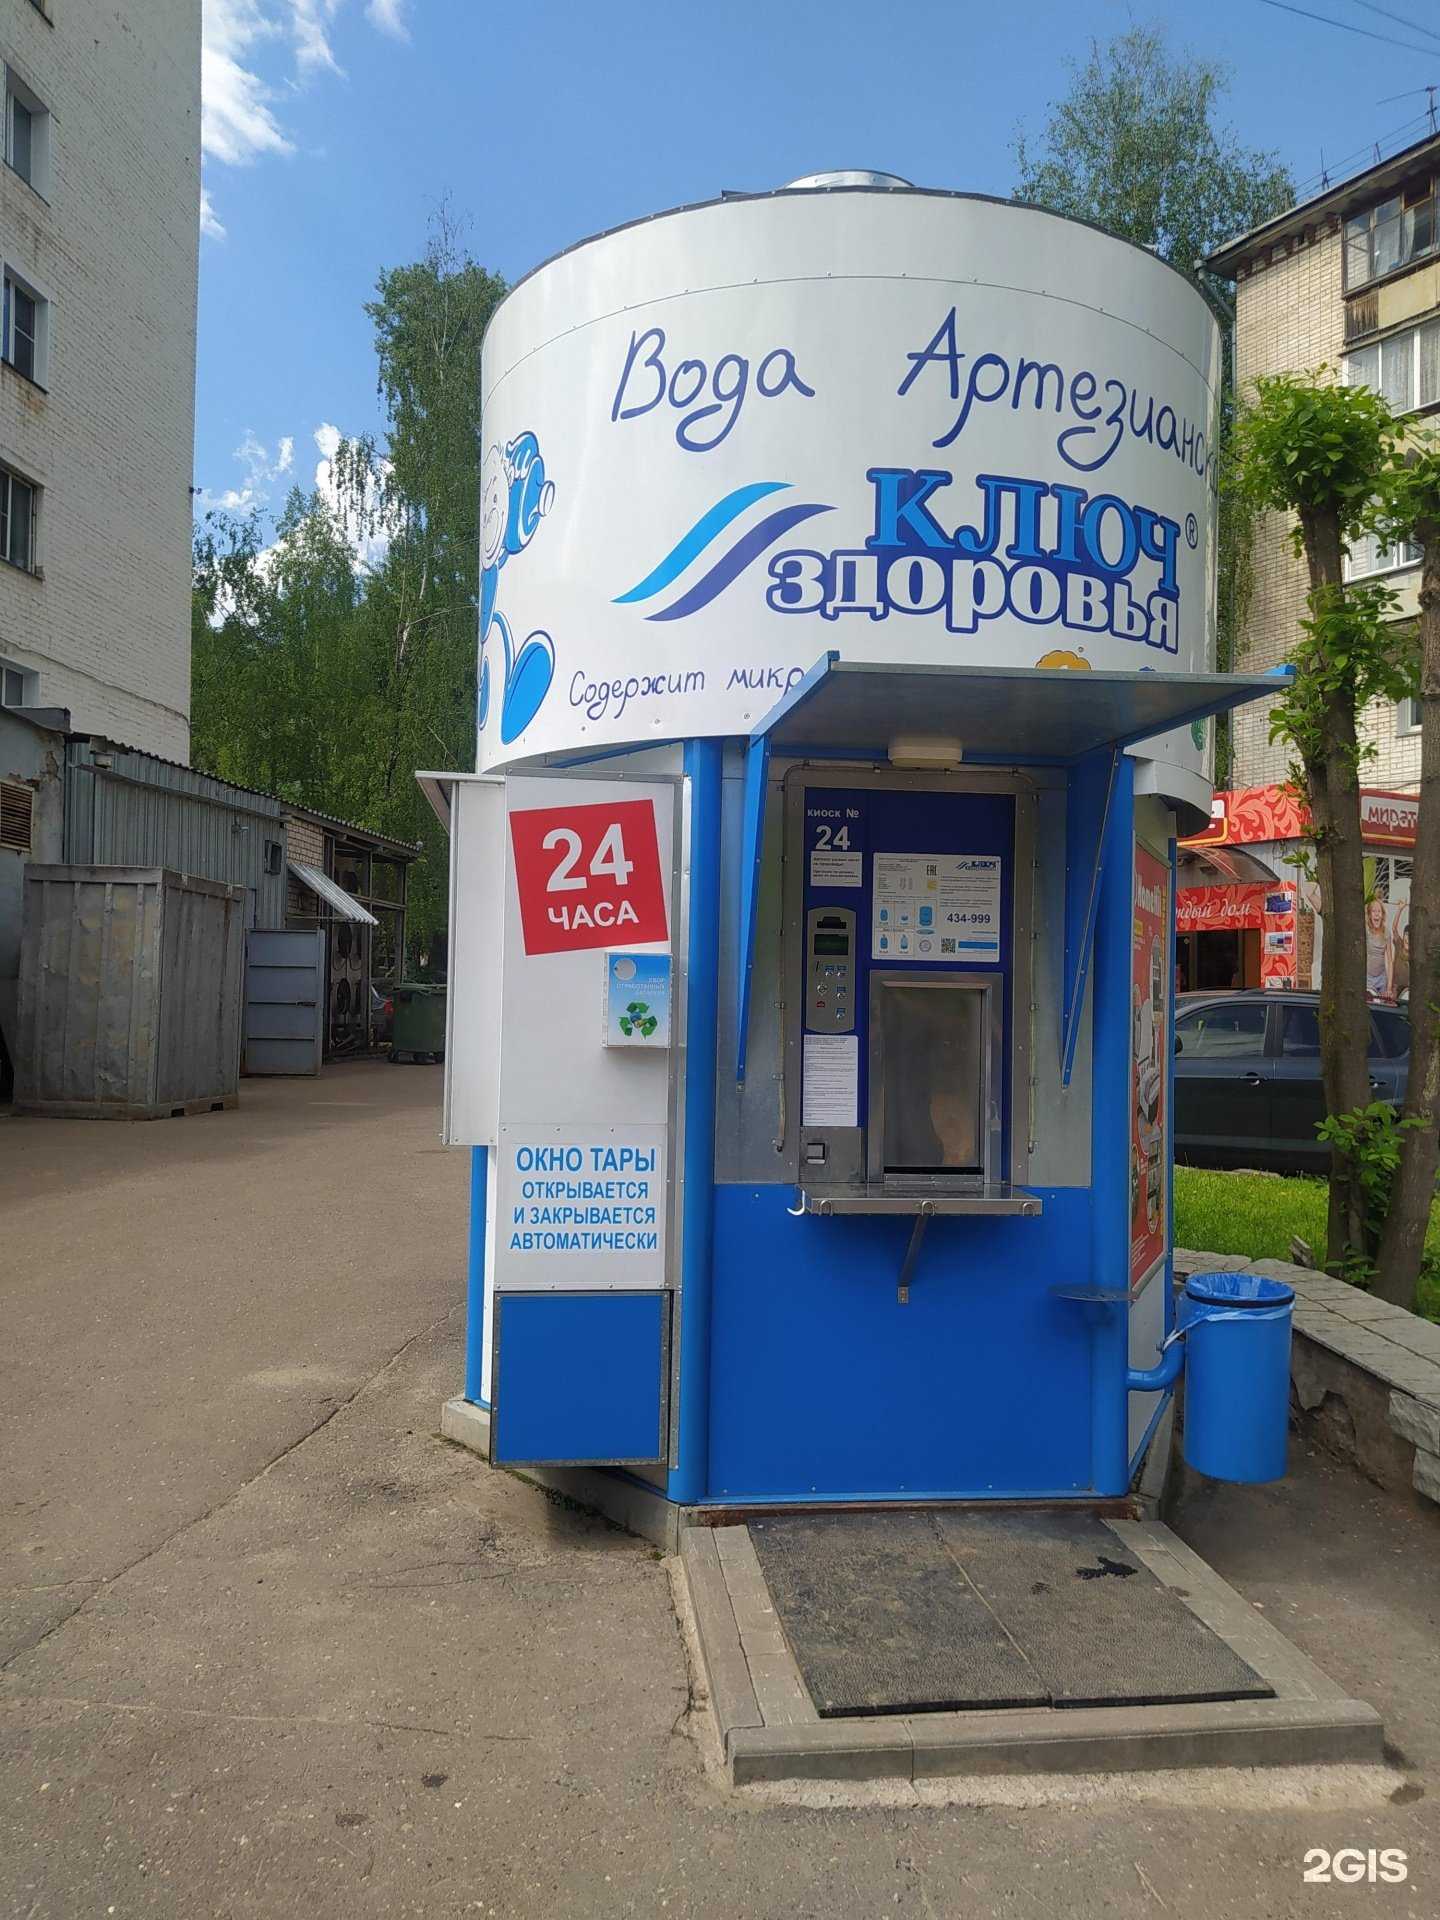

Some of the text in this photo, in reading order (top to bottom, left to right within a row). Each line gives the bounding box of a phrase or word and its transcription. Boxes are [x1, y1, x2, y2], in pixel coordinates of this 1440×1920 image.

[610, 327, 815, 453] Вода
[866, 467, 1182, 595] КЛЮЧ
[766, 549, 1179, 653] здоровья
[569, 670, 705, 720] Содержит
[815, 825, 850, 850] 24
[542, 823, 634, 892] 24
[547, 900, 639, 930] ЧАСА
[946, 913, 991, 924] 434-999
[1220, 898, 1251, 917] дом
[516, 1146, 656, 1172] ОКНО ТАРЫ
[522, 1181, 648, 1199] ОТКРЫВАЕТСЯ
[513, 1207, 656, 1224] И ЗАКРЫВАЕТСЯ
[510, 1232, 658, 1250] АВТОМАТИЧЕСКИ
